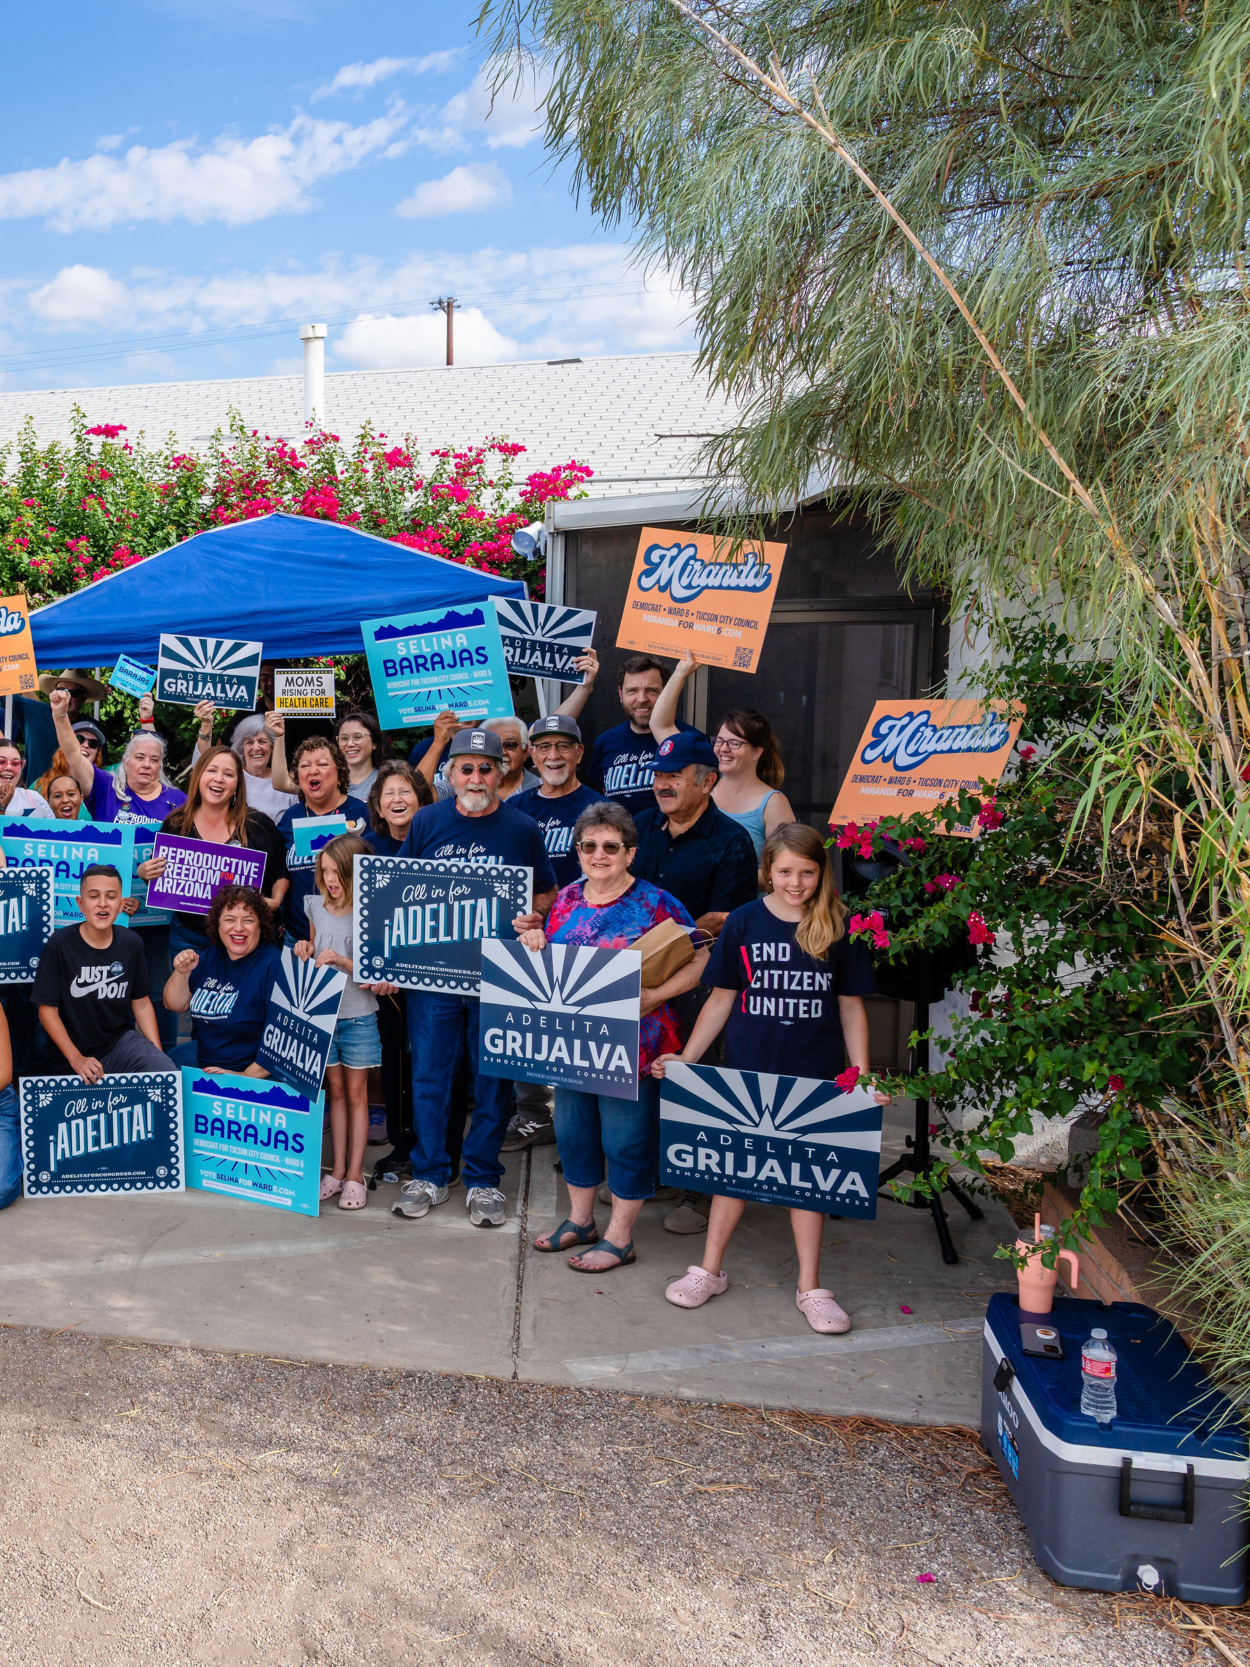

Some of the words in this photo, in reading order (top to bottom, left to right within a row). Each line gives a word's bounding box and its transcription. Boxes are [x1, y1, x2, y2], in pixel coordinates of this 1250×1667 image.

[639, 545, 770, 600] Miranda
[632, 600, 662, 612] DEMOCRAT
[668, 606, 684, 616] WARD
[685, 609, 690, 618] 6
[696, 611, 718, 622] TUCSON
[719, 614, 732, 624] CITY
[733, 617, 758, 630] COUNCIL
[642, 614, 742, 638] MIRANDAFORWARD6.COM
[397, 633, 467, 655] SELINA
[504, 638, 568, 654] ADELITA
[8, 653, 30, 663] COUNCIL
[383, 646, 489, 677] BARAJAS
[119, 666, 150, 685] BARAJAS
[178, 672, 237, 684] ADELITA
[285, 676, 323, 687] MOMS
[473, 670, 486, 678] WARD
[164, 678, 248, 699] GRIJALVA
[280, 698, 309, 708] HEALTH
[311, 698, 329, 708] CARE
[862, 711, 1008, 769] Miranda
[851, 774, 882, 784] DEMOCRAT
[888, 776, 905, 785] WARD
[906, 777, 912, 785] 6
[918, 778, 942, 788] TUCSON
[943, 780, 959, 789] CITY
[24, 843, 99, 861] SELINA
[159, 846, 259, 878] REPRODUCTIVE
[435, 845, 453, 858] All
[456, 846, 466, 856] in
[468, 842, 486, 860] for
[220, 872, 234, 880] FOR
[154, 877, 212, 900] ARIZONA
[402, 884, 427, 903] All
[431, 885, 445, 897] in
[448, 880, 471, 904] for
[384, 897, 499, 959] ¡ADELITA!
[751, 942, 790, 962] END
[77, 966, 110, 983] JUST
[190, 988, 239, 1015] ADELITA!
[749, 996, 822, 1018] UNITED
[276, 1012, 318, 1044] ADELITA
[505, 1012, 609, 1036] ADELITA
[264, 1024, 322, 1079] GRIJALVA
[484, 1028, 633, 1074] GRIJALVA
[484, 1056, 535, 1069] DEMOCRAT
[576, 1070, 633, 1084] CONGRESS
[65, 1100, 88, 1118] All
[92, 1097, 105, 1111] in
[108, 1091, 127, 1115] for
[212, 1101, 287, 1128] SELINA
[49, 1102, 153, 1172] ¡ADELITA!
[194, 1114, 304, 1154] BARAJAS
[194, 1138, 218, 1150] DEMOCRAT
[219, 1143, 228, 1151] FOR
[229, 1145, 248, 1156] TUCSON
[248, 1149, 259, 1158] CITY
[260, 1151, 280, 1163] COUNCIL
[285, 1157, 299, 1166] WARD
[696, 1131, 839, 1163] ADELITA
[61, 1171, 146, 1179] ADELITAFORCONGRESS.COM
[200, 1169, 295, 1196] VOTESELINAFORWARD5.COM
[666, 1144, 870, 1197] GRIJALVA
[666, 1167, 736, 1184] DEMOCRAT
[754, 1183, 777, 1191] FOR
[795, 1189, 869, 1206] CONGRESS
